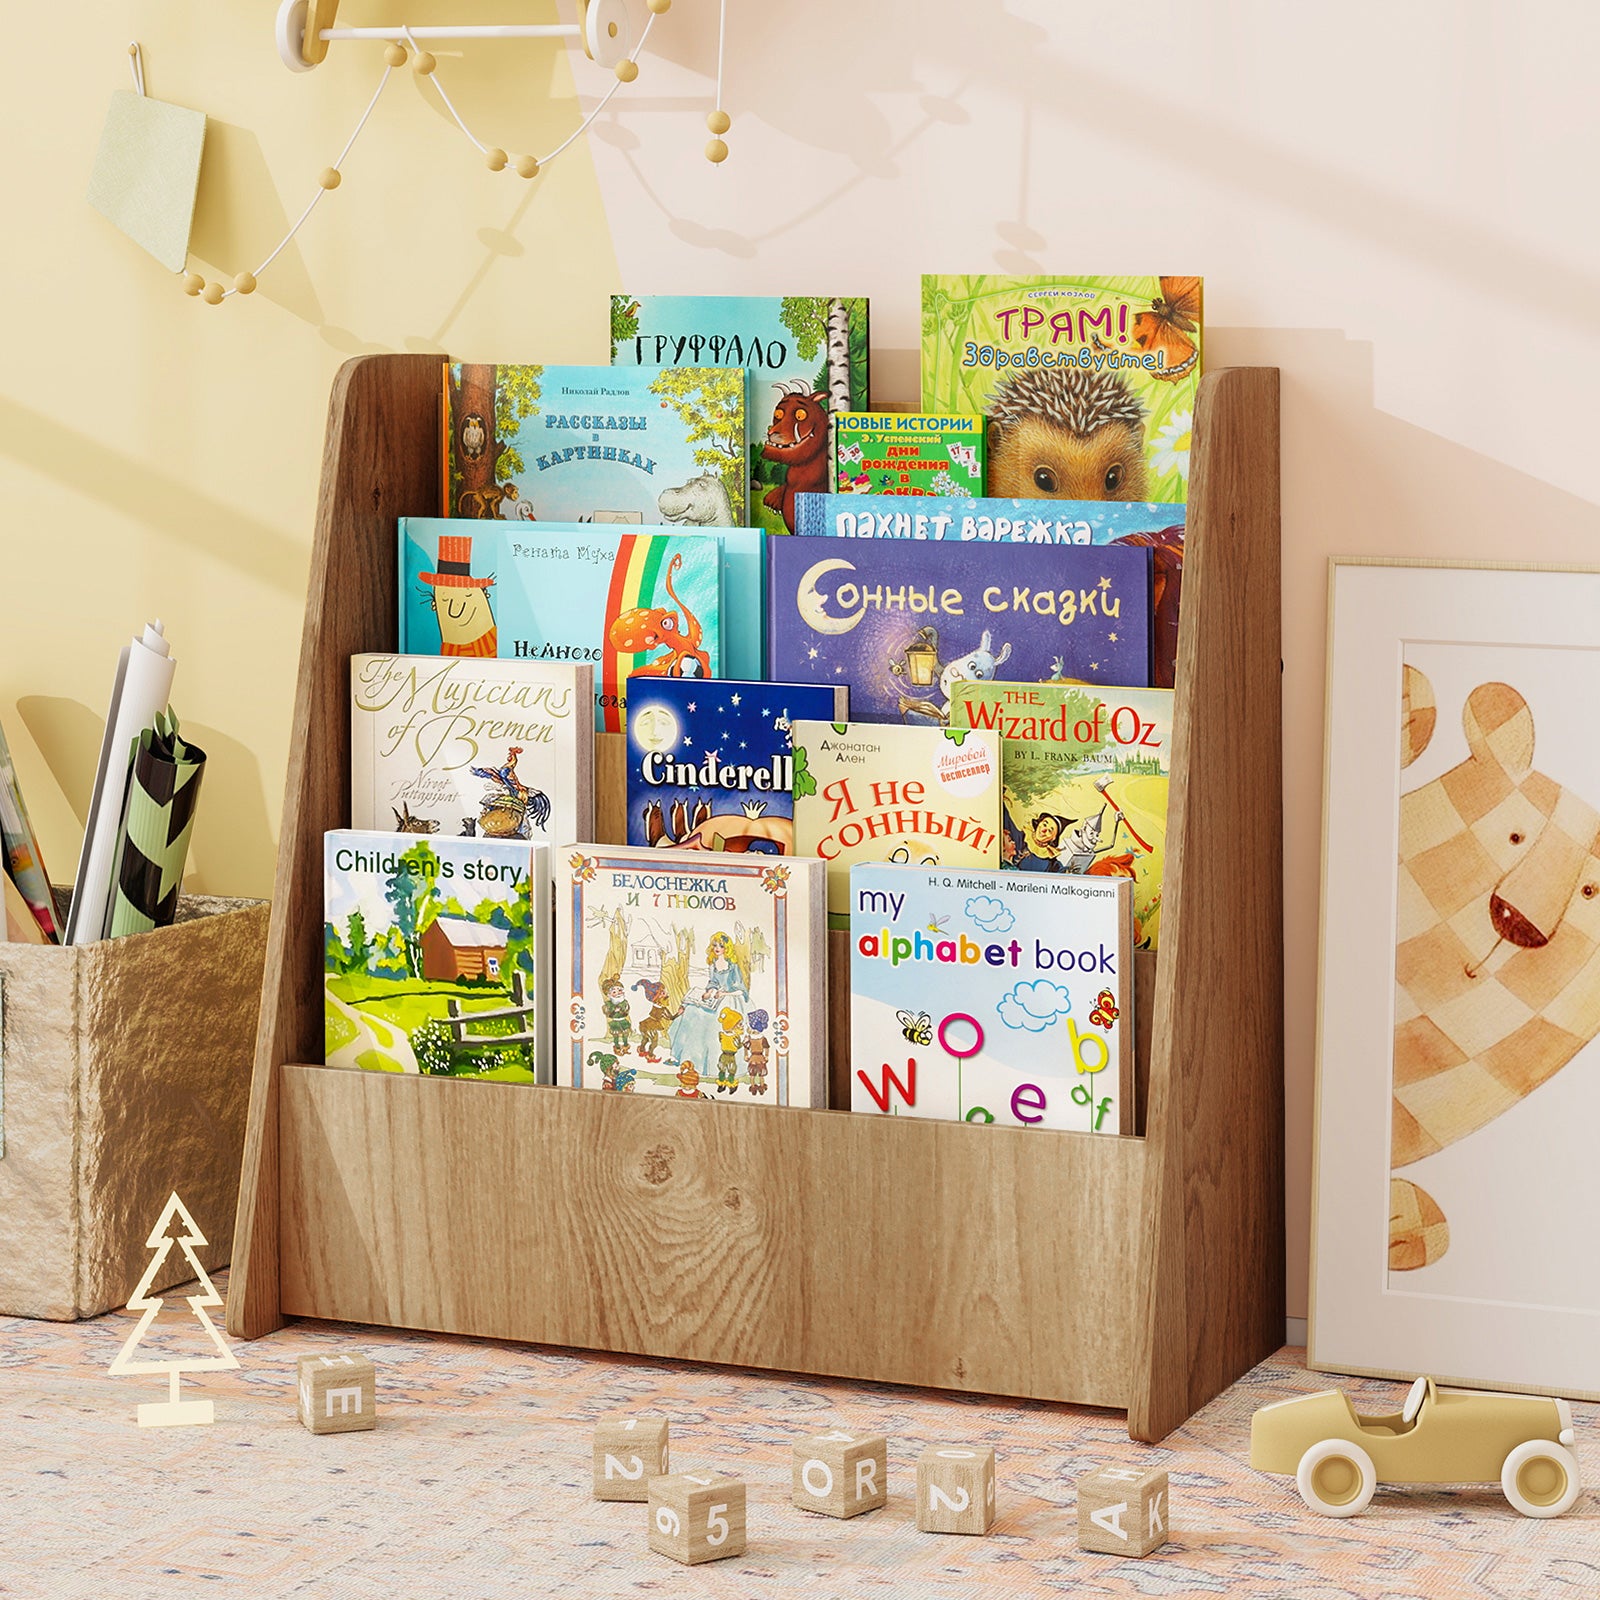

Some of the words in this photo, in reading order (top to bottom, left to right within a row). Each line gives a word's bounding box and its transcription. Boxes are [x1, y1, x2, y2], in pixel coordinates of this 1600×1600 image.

[996, 304, 1128, 344] ТРЯМ!
[635, 334, 787, 369] ГРУФФАЛО
[963, 342, 1165, 371] Здравствуйте!
[561, 386, 599, 397] Николай
[600, 386, 630, 397] Радлов
[545, 414, 648, 431] РАССКАЗЫ
[837, 416, 892, 431] НОВЫЕ
[896, 418, 973, 431] ИСТОРИИ
[875, 433, 942, 444] Успенский
[536, 445, 658, 476] КАРТИНКАХ
[861, 459, 949, 471] рождения
[513, 544, 570, 560] Рената
[577, 545, 615, 564] Муха
[983, 584, 1120, 625] сказки
[355, 660, 572, 718] Musicians
[359, 656, 405, 699] The
[1004, 691, 1045, 706] THE
[380, 709, 427, 757] of
[415, 706, 554, 770] Bremen
[964, 700, 1067, 743] Wizard
[1074, 704, 1107, 744] of
[1111, 707, 1162, 747] Oz
[820, 739, 881, 753] Джонатан
[835, 752, 866, 764] Ален
[1014, 750, 1028, 760] BY
[1031, 751, 1041, 761] L.
[1044, 752, 1078, 762] FRANK
[1083, 753, 1113, 764] BAUM
[941, 763, 990, 783] бестселлер
[823, 778, 859, 823] Я
[870, 780, 925, 807] не
[336, 849, 455, 878] Children's
[464, 858, 522, 888] story
[612, 873, 728, 893] БЕЛОСНЕЖКА
[625, 892, 639, 906] И
[652, 893, 660, 907] 7
[667, 895, 736, 911] ГНОМОВ
[928, 877, 939, 887] H.
[942, 877, 954, 888] Q.
[957, 878, 997, 891] Mitchell
[1006, 882, 1048, 894] Marileni
[1050, 883, 1116, 899] Malkogianni
[859, 890, 905, 921] my
[858, 928, 1022, 967] alphabet
[1036, 939, 1116, 974] book
[1067, 1018, 1109, 1074] b
[1011, 1084, 1046, 1123] e
[326, 1386, 362, 1417] E
[605, 1454, 644, 1480] 2
[856, 1458, 879, 1500] R
[930, 1484, 969, 1512] 2
[706, 1504, 729, 1546] 5
[1091, 1501, 1127, 1541] A
[1149, 1491, 1163, 1539] K
